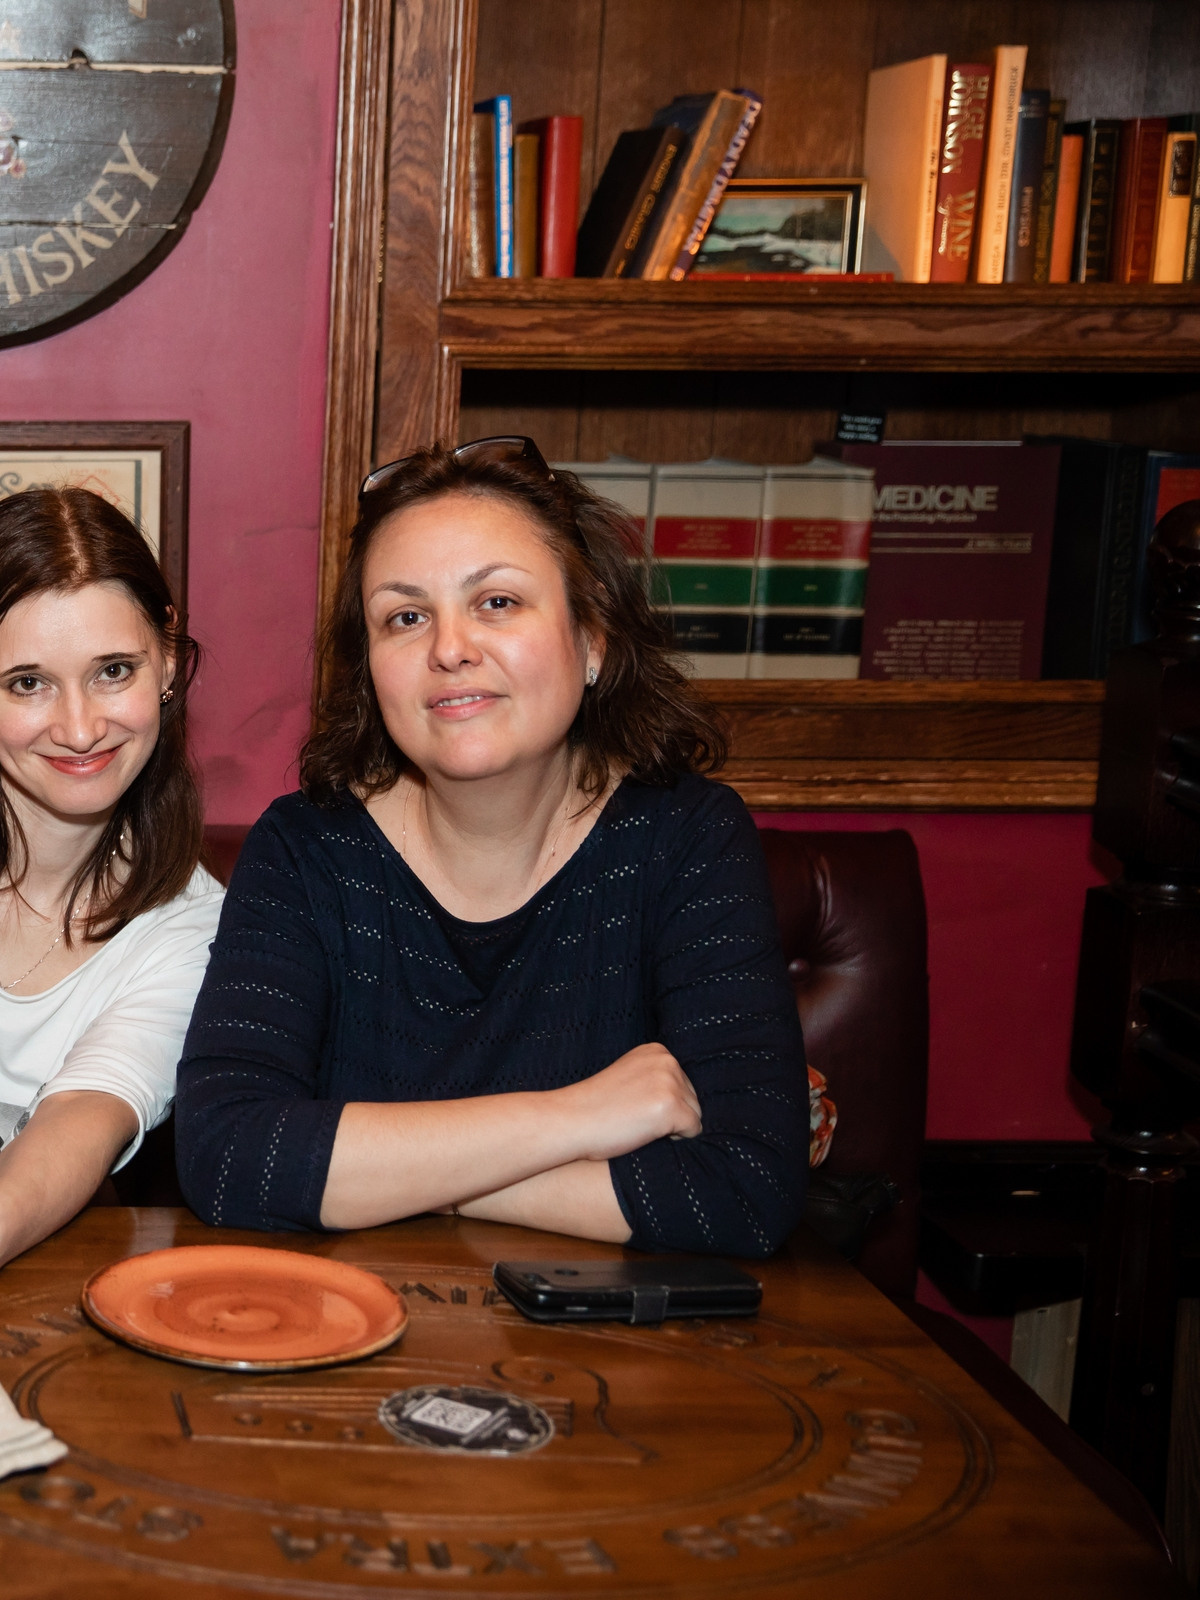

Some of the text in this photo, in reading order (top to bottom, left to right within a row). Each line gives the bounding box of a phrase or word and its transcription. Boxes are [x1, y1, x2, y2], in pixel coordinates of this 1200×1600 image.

[948, 190, 976, 261] WINE
[873, 485, 999, 511] MEDICINE
[18, 1474, 203, 1545] STO
[267, 1525, 617, 1579] EXTRA
